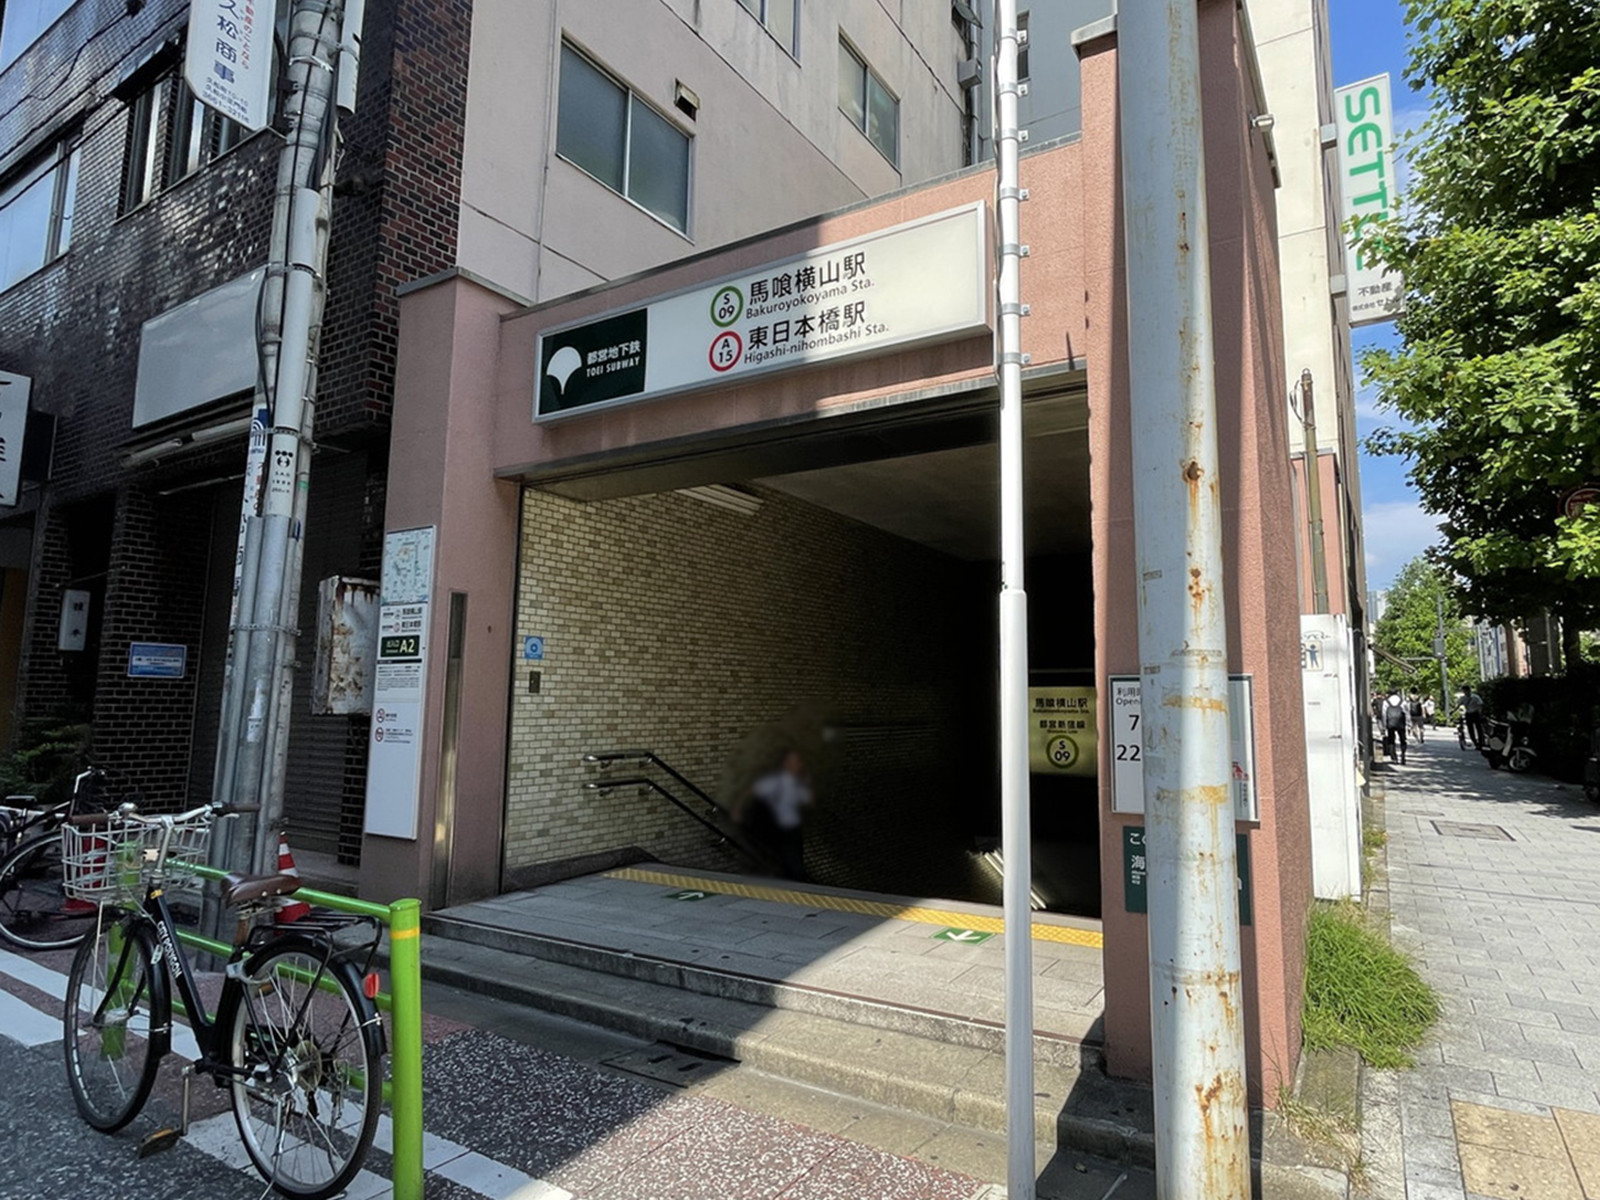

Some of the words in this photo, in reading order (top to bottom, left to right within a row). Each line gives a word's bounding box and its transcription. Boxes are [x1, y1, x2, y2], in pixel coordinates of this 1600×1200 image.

[1345, 86, 1390, 271] SETTL
[749, 252, 866, 304] 馬喰横山駅
[746, 284, 848, 319] Bakuroyokoyama
[851, 277, 875, 292] Sta.
[1358, 282, 1392, 297] 不動産
[723, 293, 730, 305] S
[719, 305, 735, 319] 09
[748, 301, 865, 350] 東日本橋駅
[722, 338, 730, 349] A
[744, 328, 861, 364] Higashi-nihombashi
[865, 323, 889, 336] Sta.
[587, 340, 640, 365] 都営地下鉄
[718, 351, 733, 363] 15
[586, 365, 604, 378] TOEI
[606, 356, 640, 373] SUBWAY
[400, 638, 415, 653] A2
[1129, 714, 1140, 731] 7
[1059, 740, 1066, 750] S
[1116, 744, 1141, 761] 22
[1054, 751, 1071, 762] 09
[157, 920, 168, 940] CITY
[163, 937, 183, 978] POLYGON
